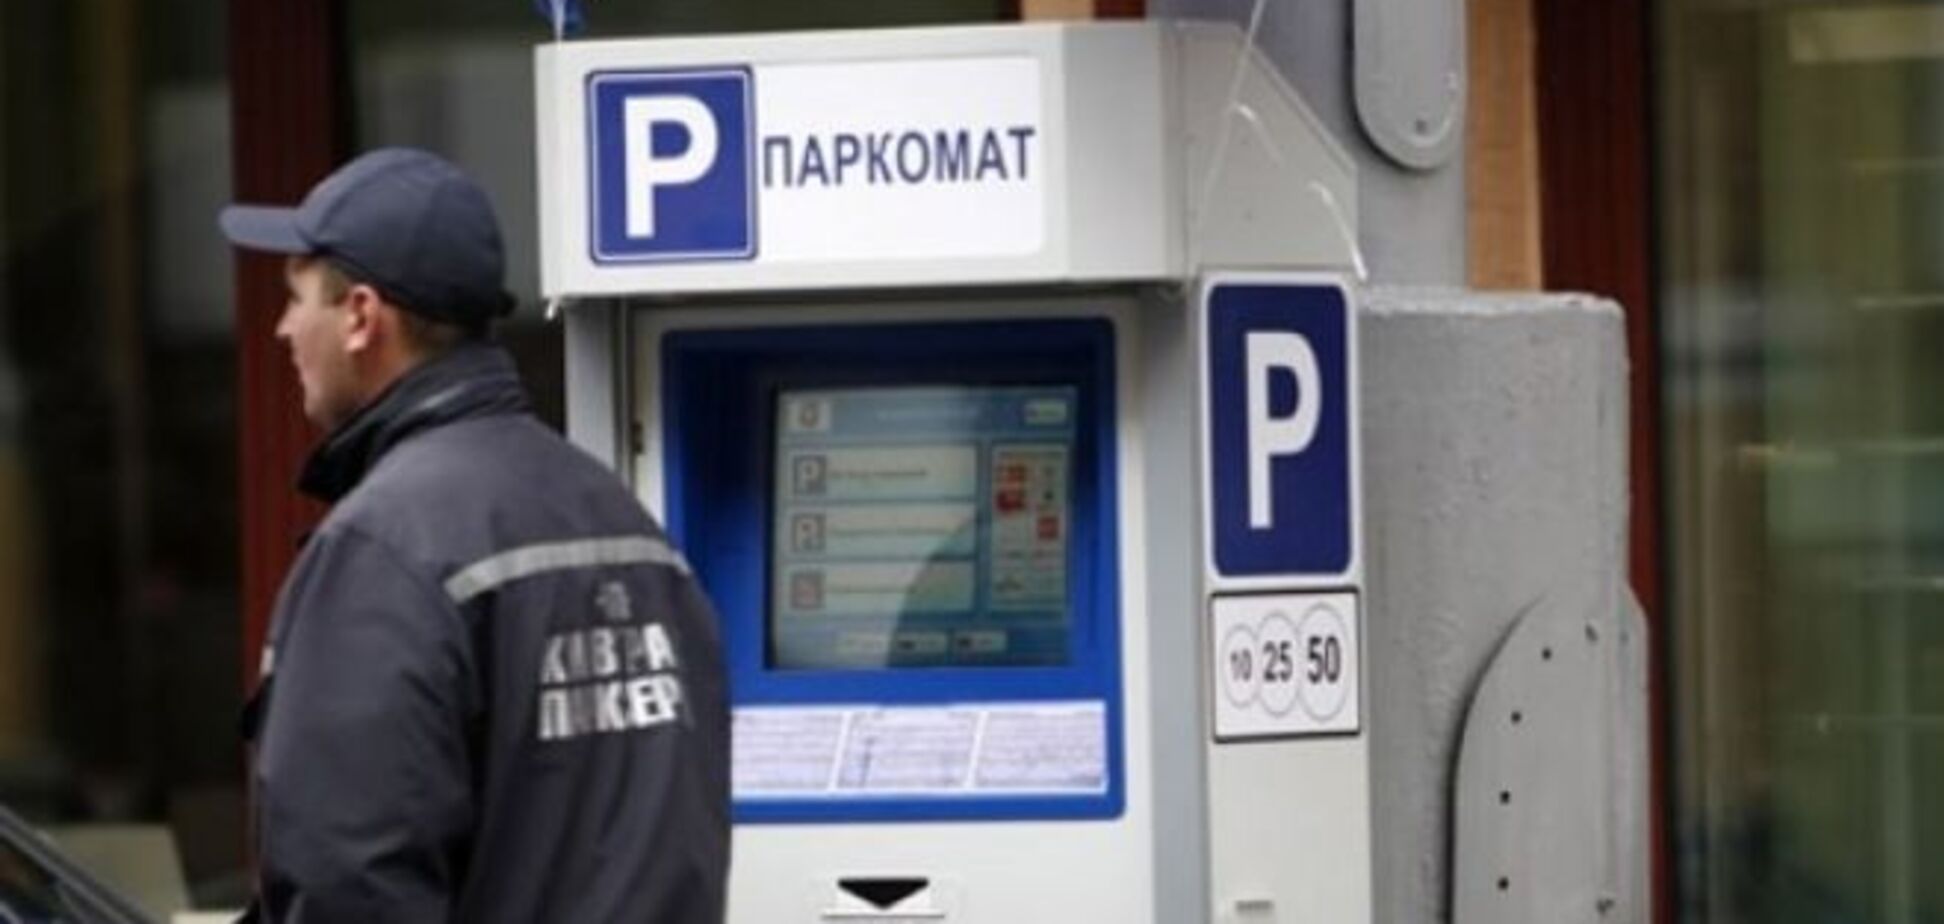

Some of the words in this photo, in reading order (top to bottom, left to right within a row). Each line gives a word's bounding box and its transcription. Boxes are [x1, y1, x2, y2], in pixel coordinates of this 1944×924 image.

[624, 94, 719, 239] P
[762, 126, 1036, 187] ПАРКОМАТ
[1244, 331, 1322, 530] P
[1230, 648, 1253, 683] 10
[1263, 640, 1294, 683] 25
[1306, 633, 1342, 685] 50
